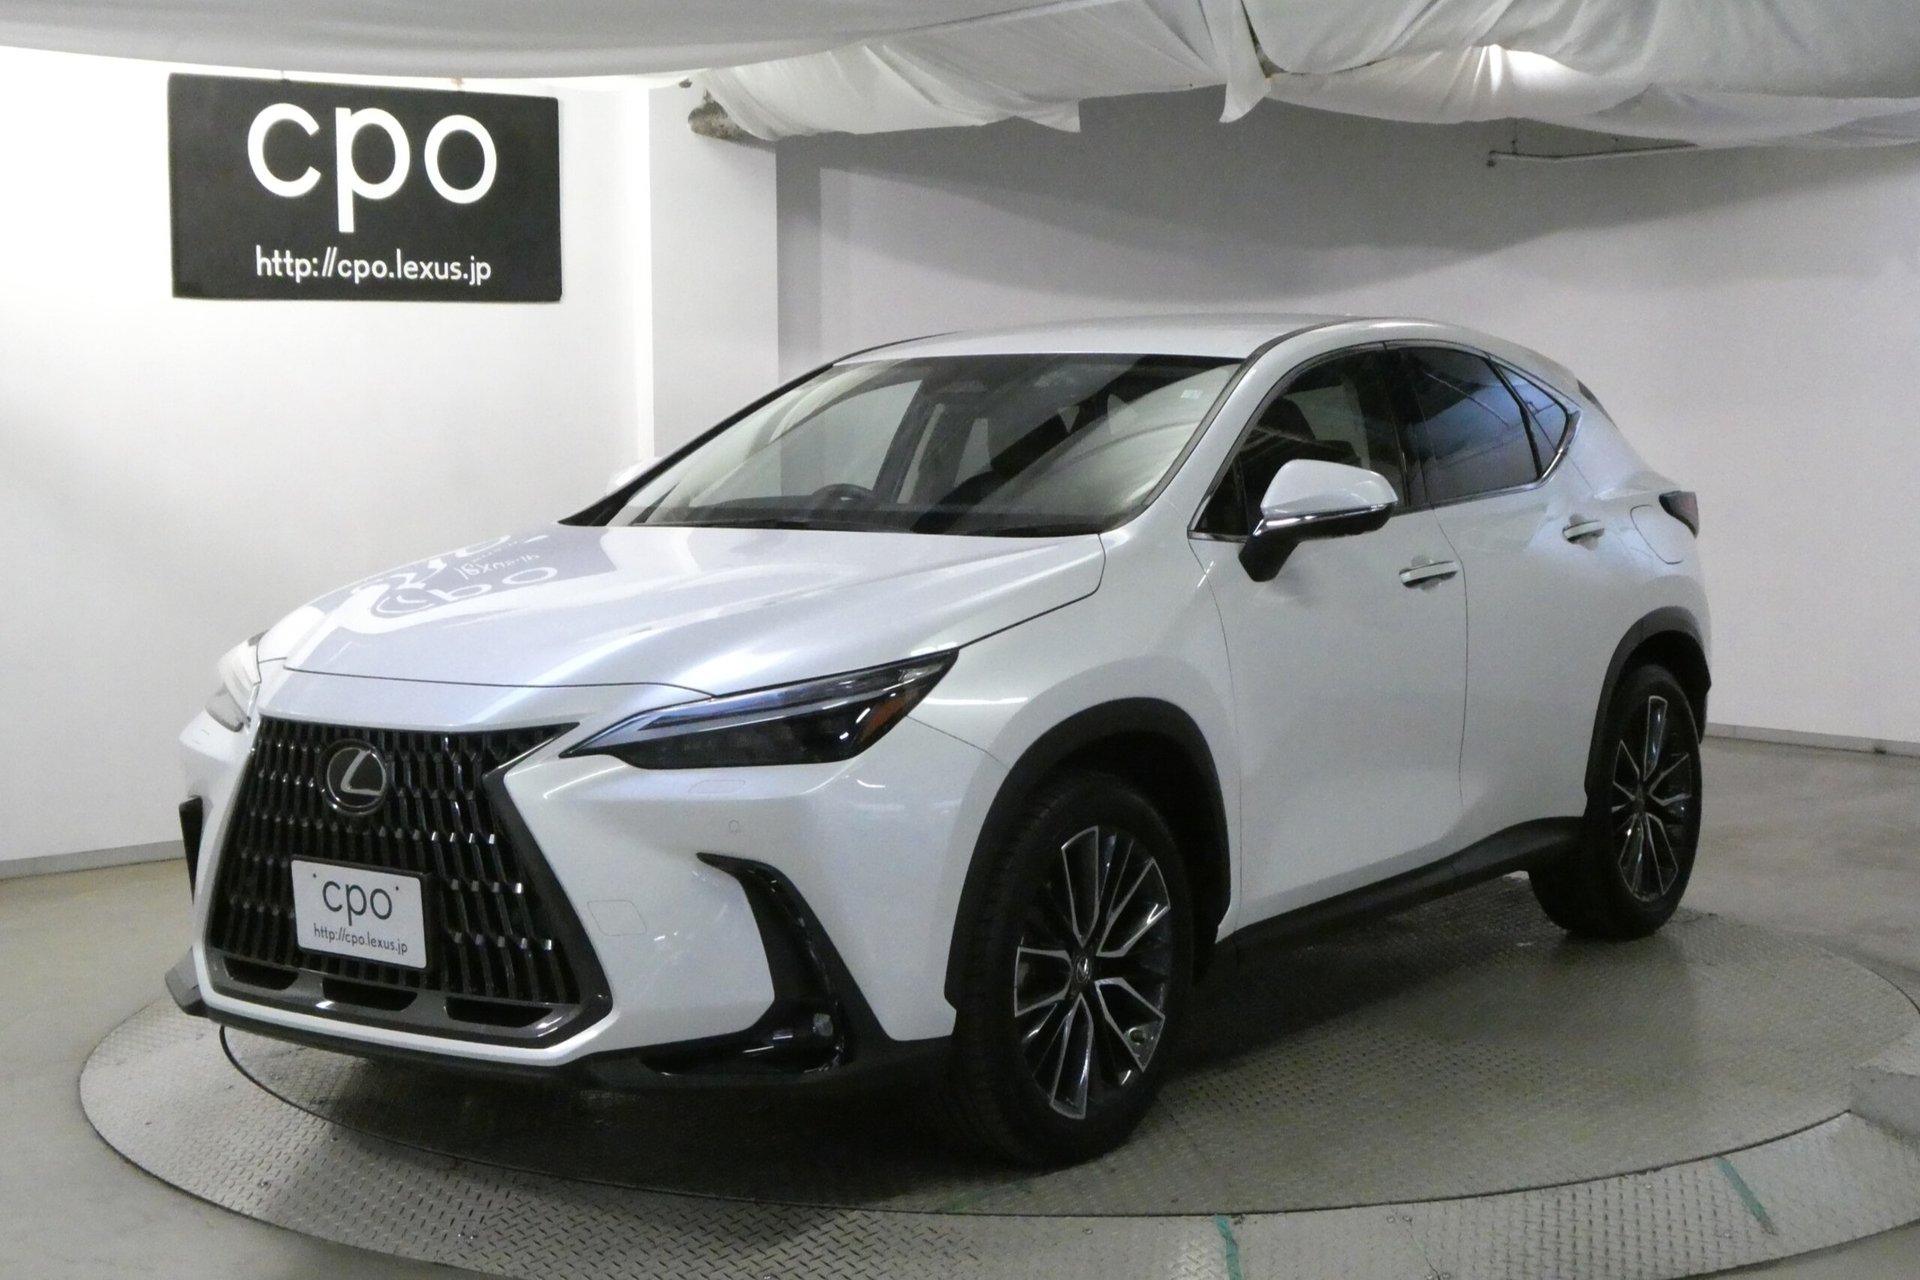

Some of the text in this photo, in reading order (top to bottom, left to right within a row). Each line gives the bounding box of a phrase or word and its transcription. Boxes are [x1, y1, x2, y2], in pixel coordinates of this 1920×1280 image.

[247, 102, 498, 233] cpo
[255, 244, 492, 285] http://cpo.lexus.jp
[322, 880, 393, 927] cpo
[313, 923, 408, 956] http://cpo.lexus.jp
